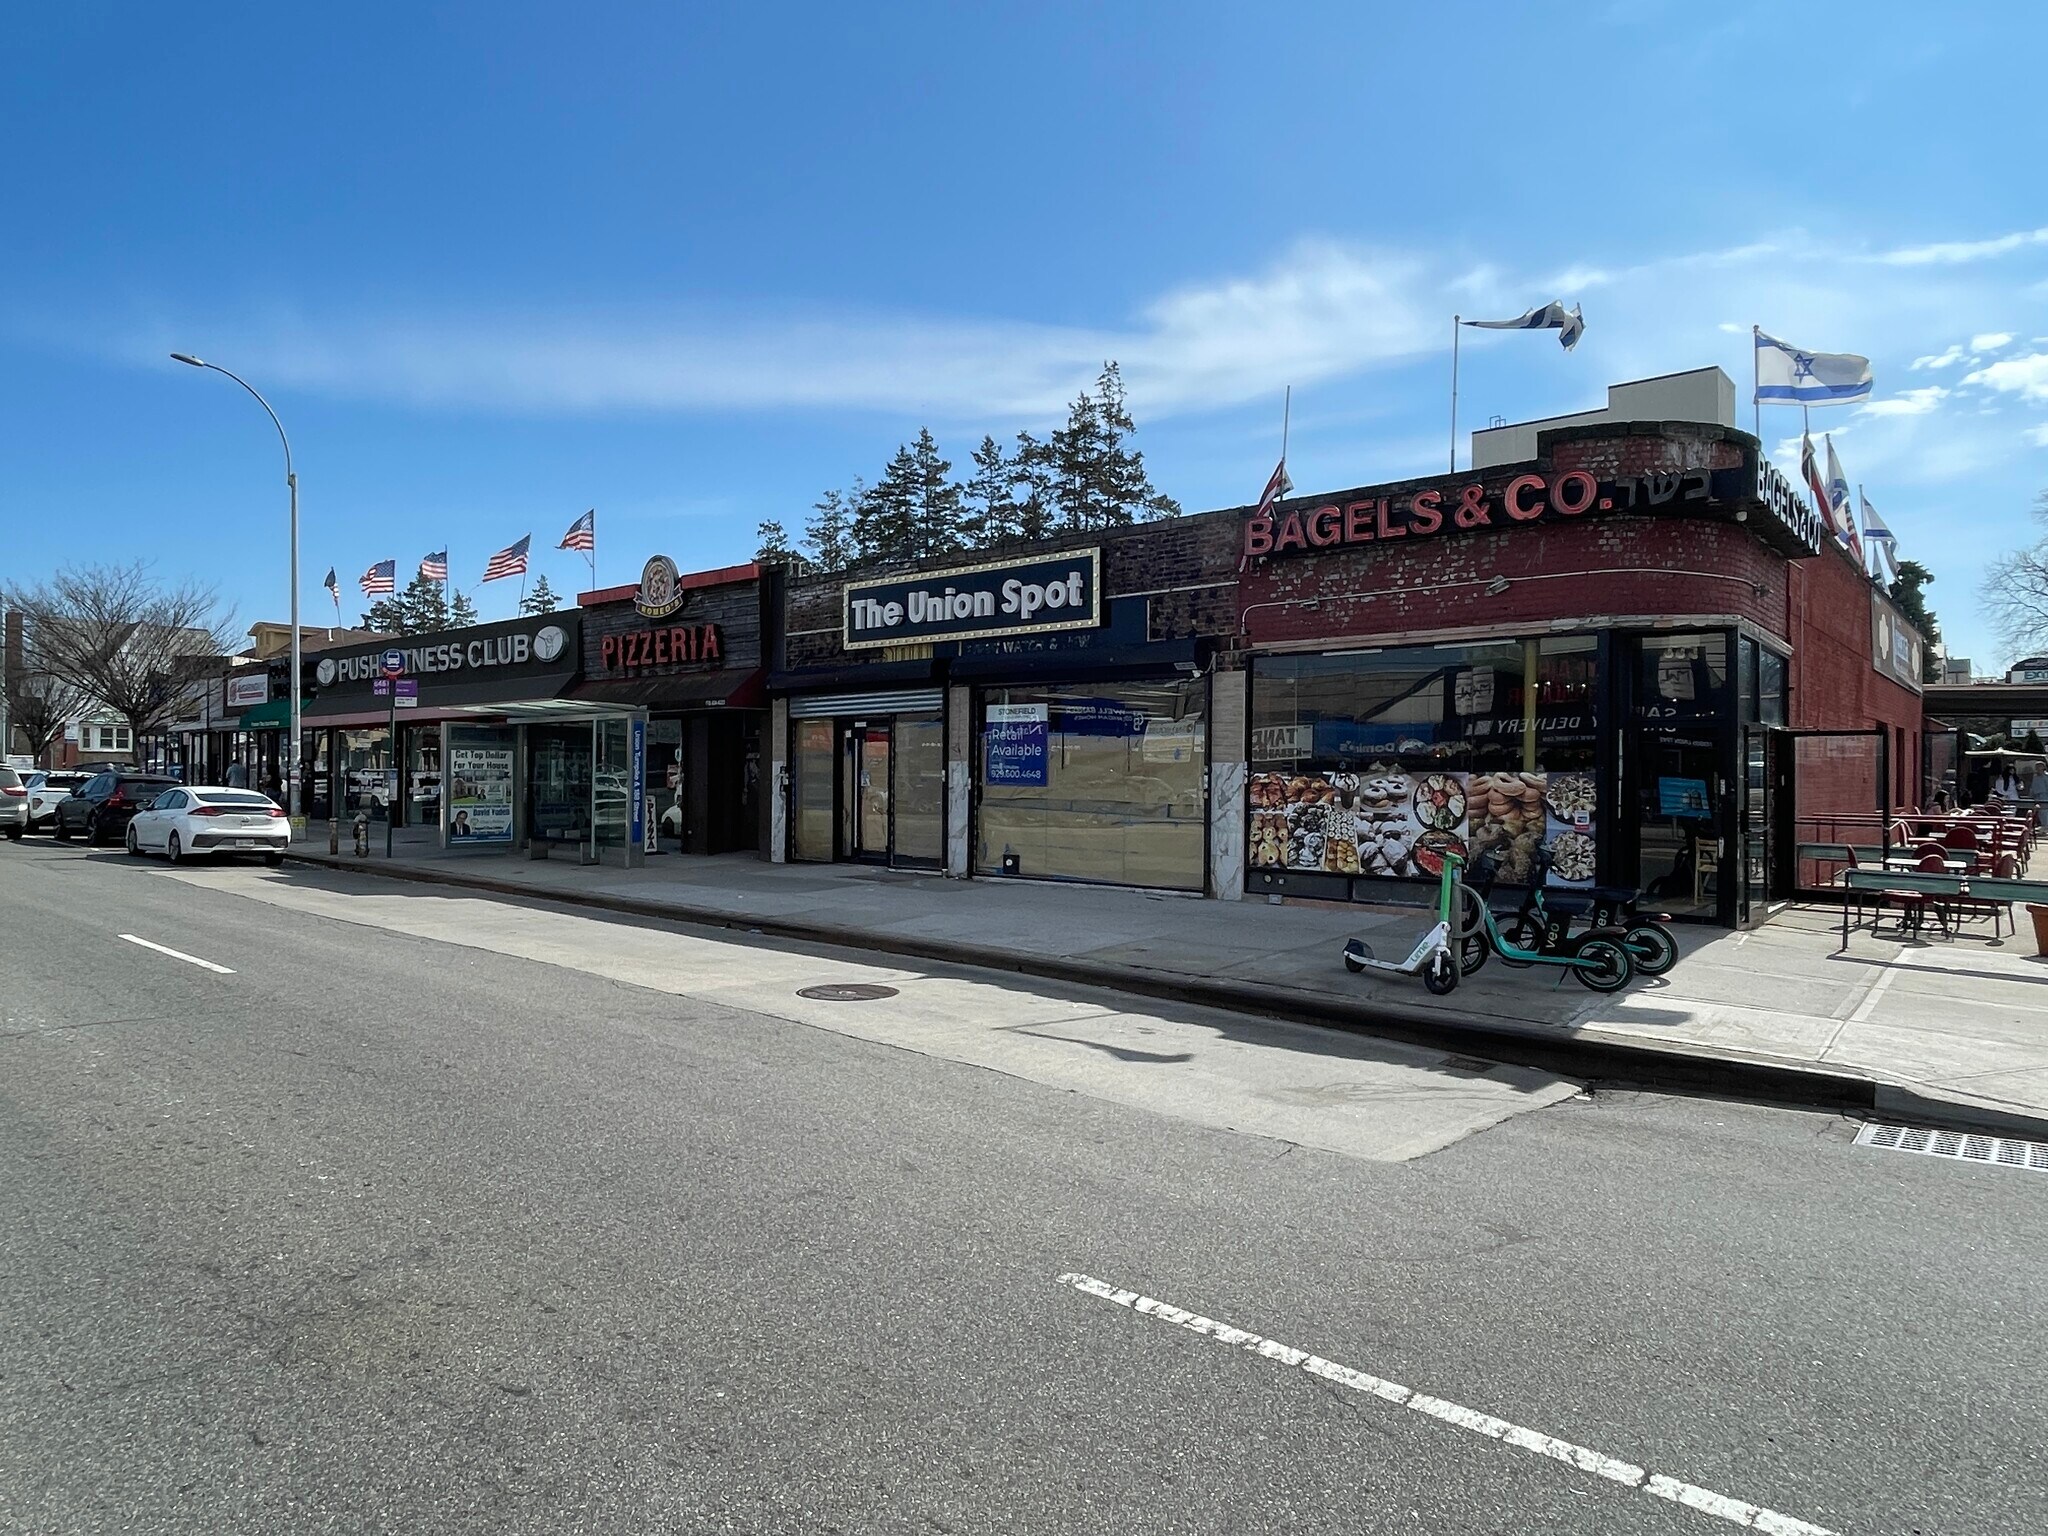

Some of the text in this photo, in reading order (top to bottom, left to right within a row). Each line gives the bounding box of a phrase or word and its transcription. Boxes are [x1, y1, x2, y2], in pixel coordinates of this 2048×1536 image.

[1757, 451, 1799, 536] BAGELS
[1244, 470, 1613, 557] BAGELS & CO.
[851, 571, 1083, 632] The Union Spot
[601, 623, 720, 668] PIZZERIA
[337, 656, 381, 683] PUSH
[467, 633, 530, 668] CLUB
[998, 707, 1037, 716] STONEFIELD
[992, 729, 1023, 741] Retail
[455, 750, 507, 760] Get Top Dollar
[991, 743, 1042, 756] Available
[454, 760, 509, 770] For Your House
[473, 808, 490, 817] David
[647, 803, 656, 849] PIZZA
[1545, 922, 1560, 949] veo
[1410, 940, 1430, 962] Lime
